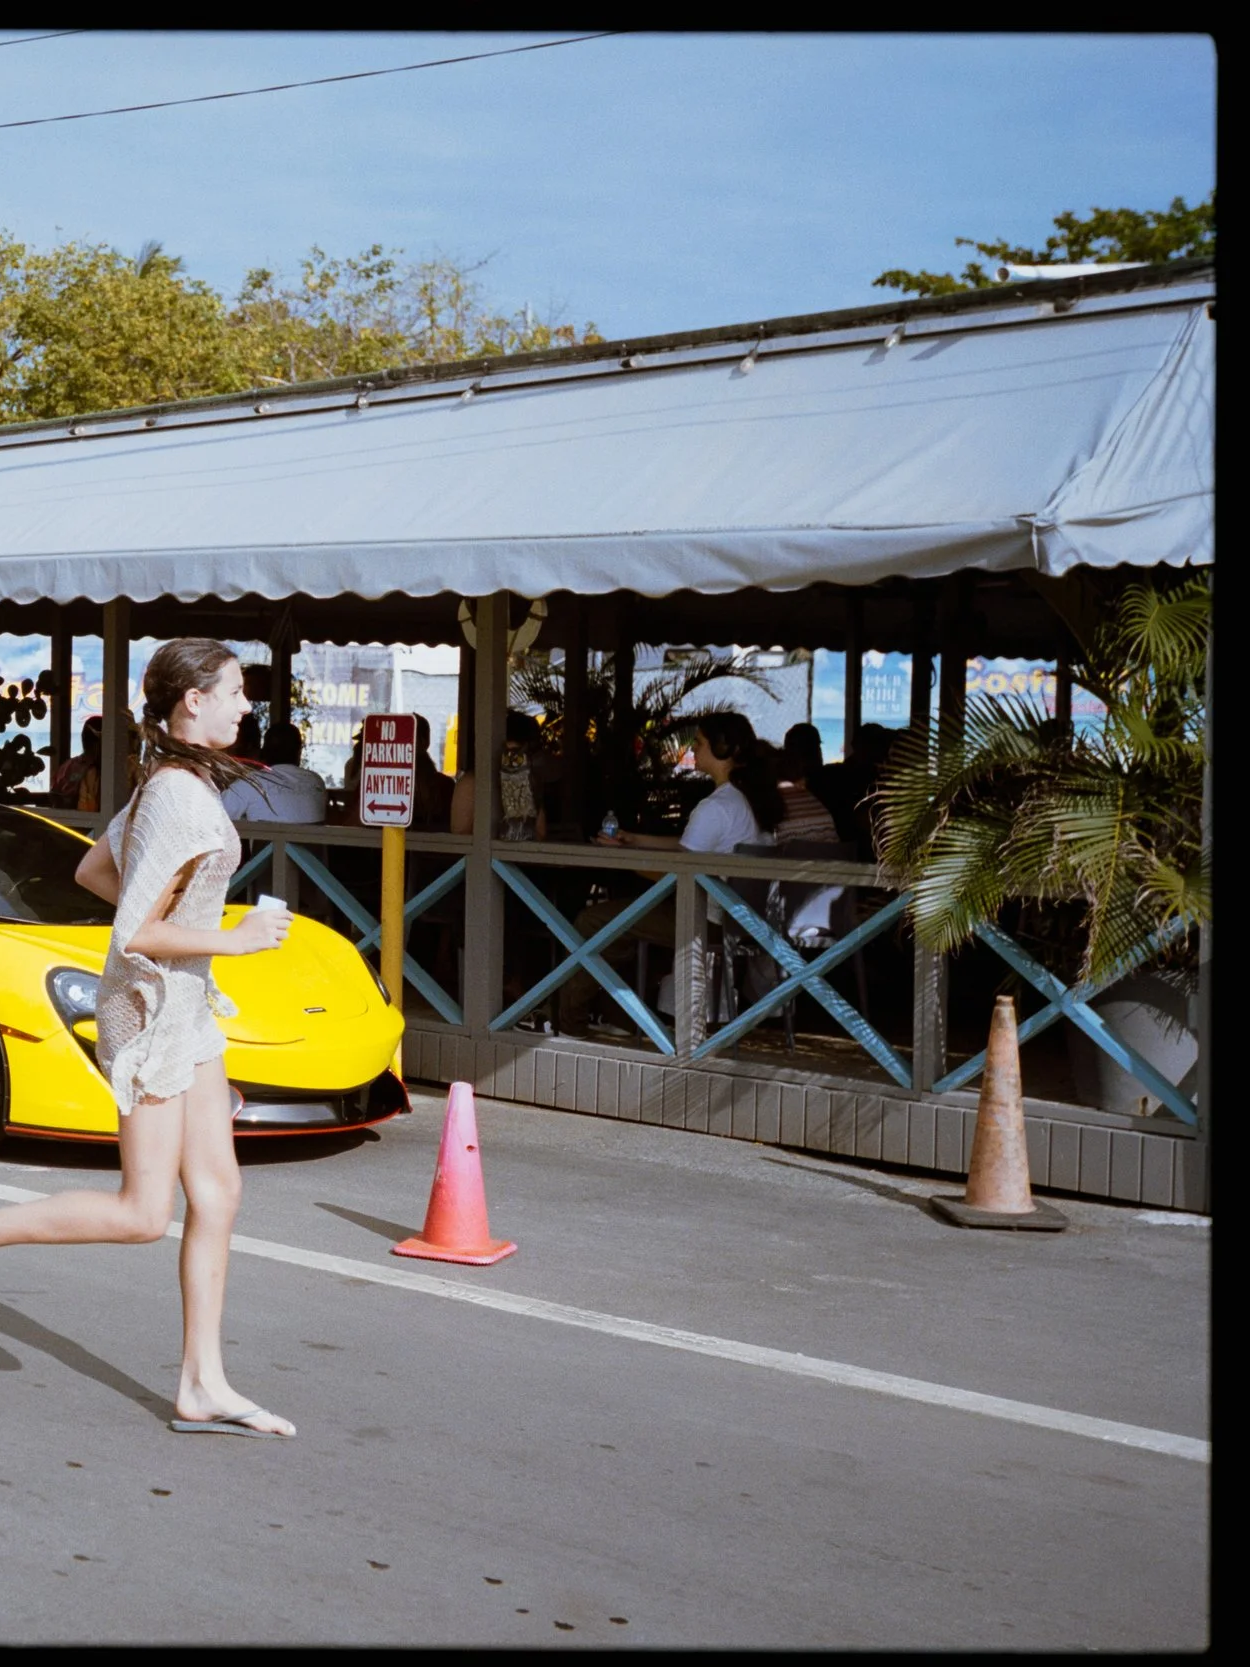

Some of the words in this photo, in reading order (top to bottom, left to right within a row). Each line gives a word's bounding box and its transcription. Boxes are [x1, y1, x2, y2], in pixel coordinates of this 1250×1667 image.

[380, 720, 396, 741] NO
[364, 743, 413, 764] PARKING
[365, 774, 411, 796] ANYTIME
